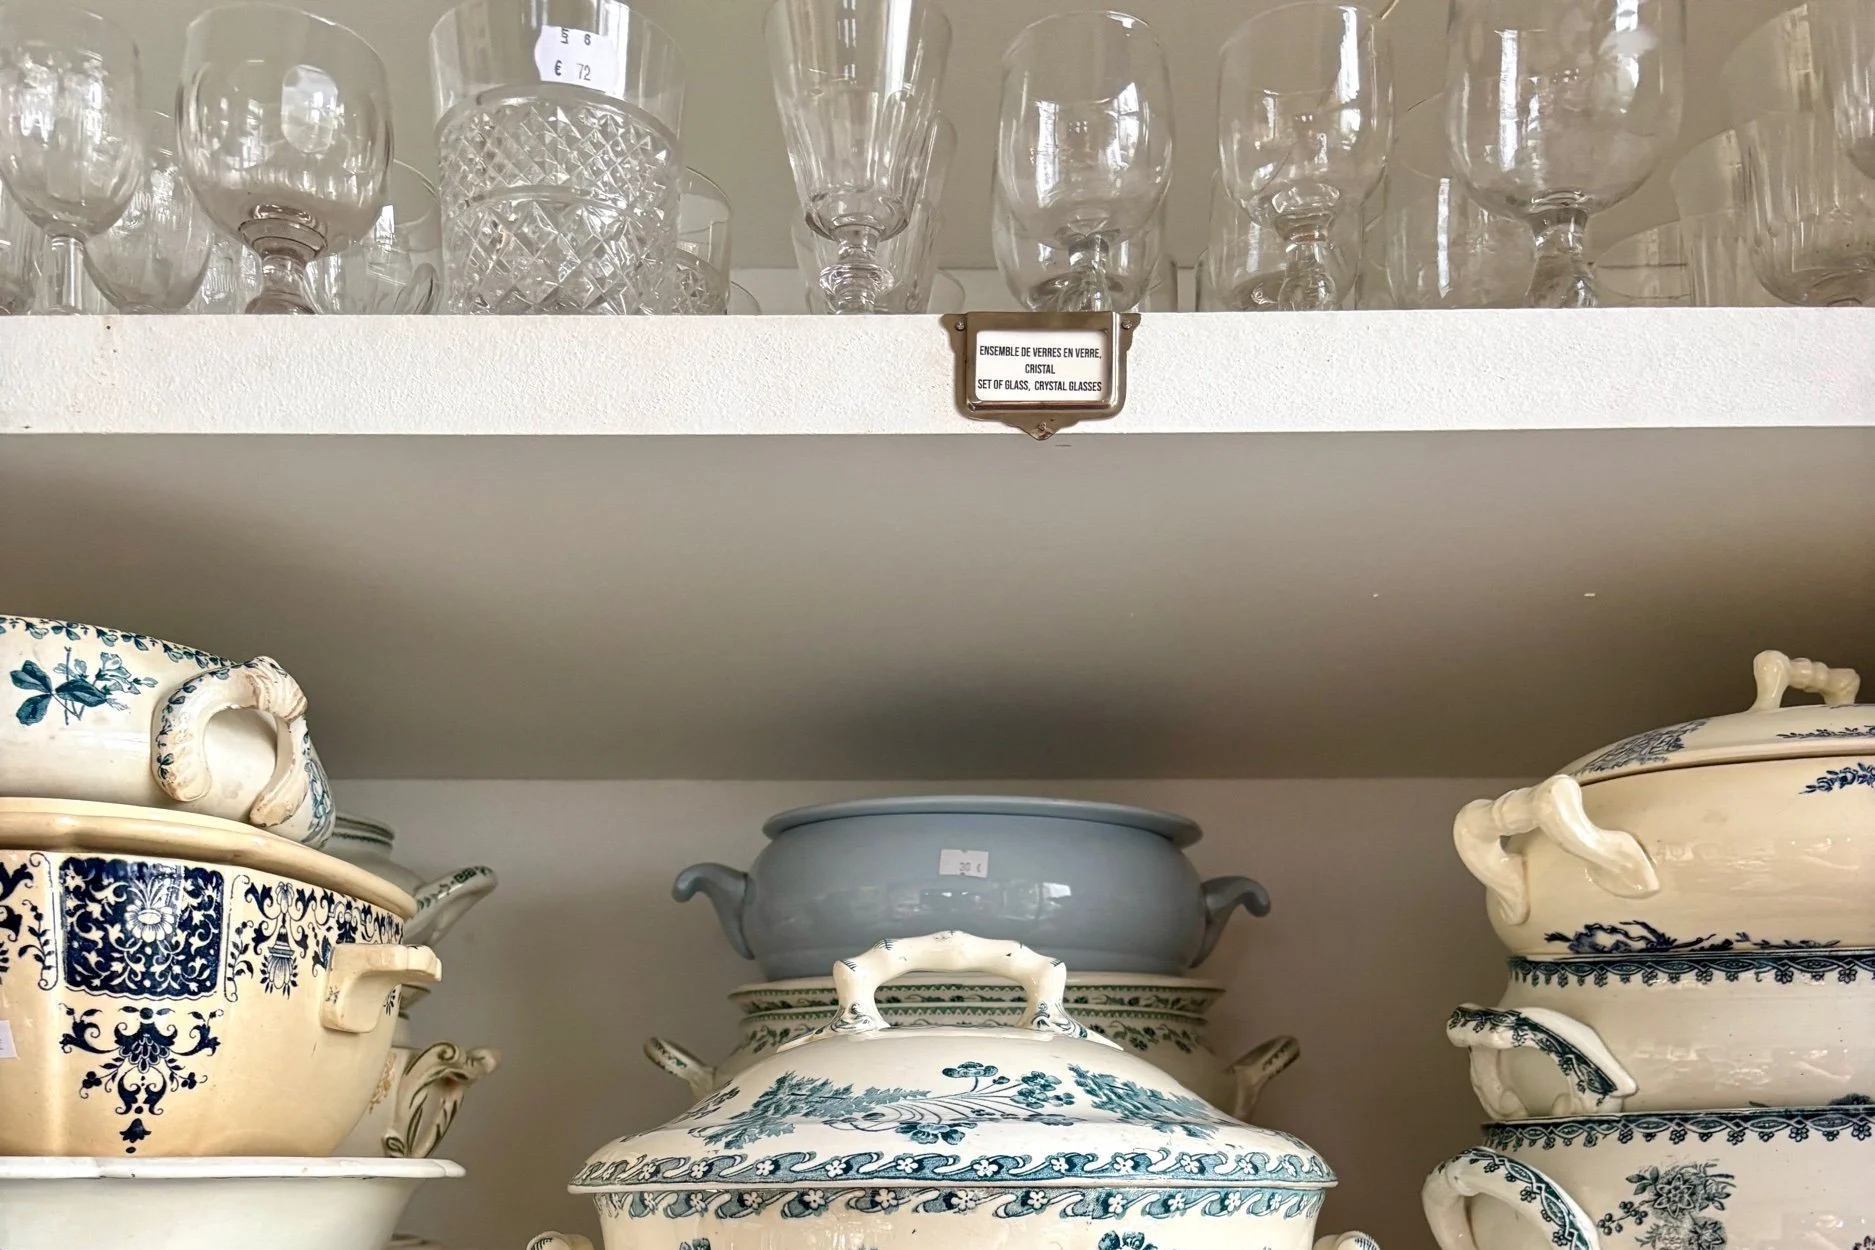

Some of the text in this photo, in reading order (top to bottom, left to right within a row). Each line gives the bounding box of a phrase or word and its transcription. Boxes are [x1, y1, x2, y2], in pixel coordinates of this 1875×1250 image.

[554, 59, 591, 82] € 72
[980, 346, 1101, 360] ENSEMBLE DE VERRES EN VERRE,
[1025, 364, 1055, 375] CRISTAL
[978, 379, 1102, 392] SET OF GLASS, CRYSTAL GLASSES
